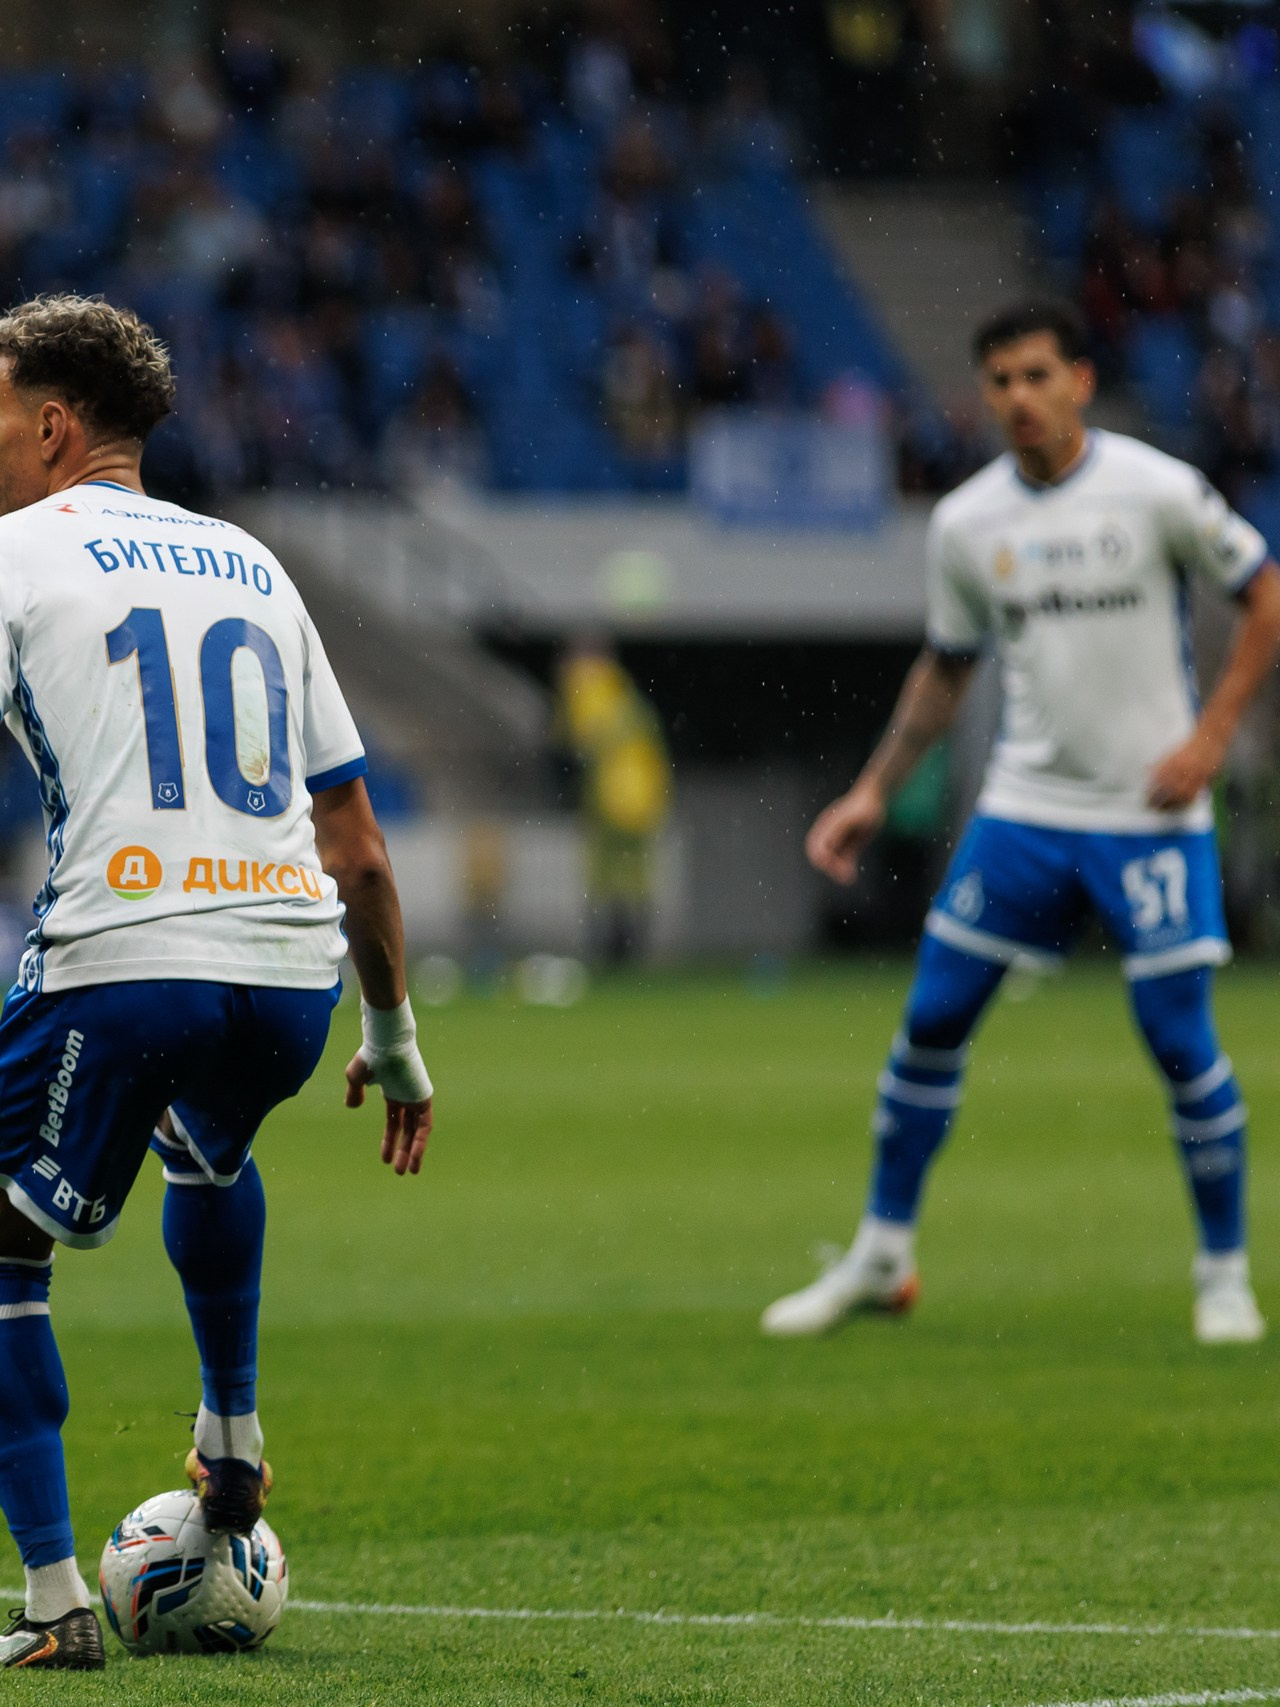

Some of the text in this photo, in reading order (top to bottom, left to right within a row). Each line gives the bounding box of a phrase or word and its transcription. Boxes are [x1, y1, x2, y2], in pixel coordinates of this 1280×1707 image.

[101, 508, 226, 528] АЭРОФЛОТ
[84, 538, 272, 596] БИТЕЛЛО
[105, 607, 293, 818] 10
[1122, 847, 1189, 930] 57
[39, 1028, 85, 1148] BetBoom
[52, 1177, 107, 1224] ВТБ
